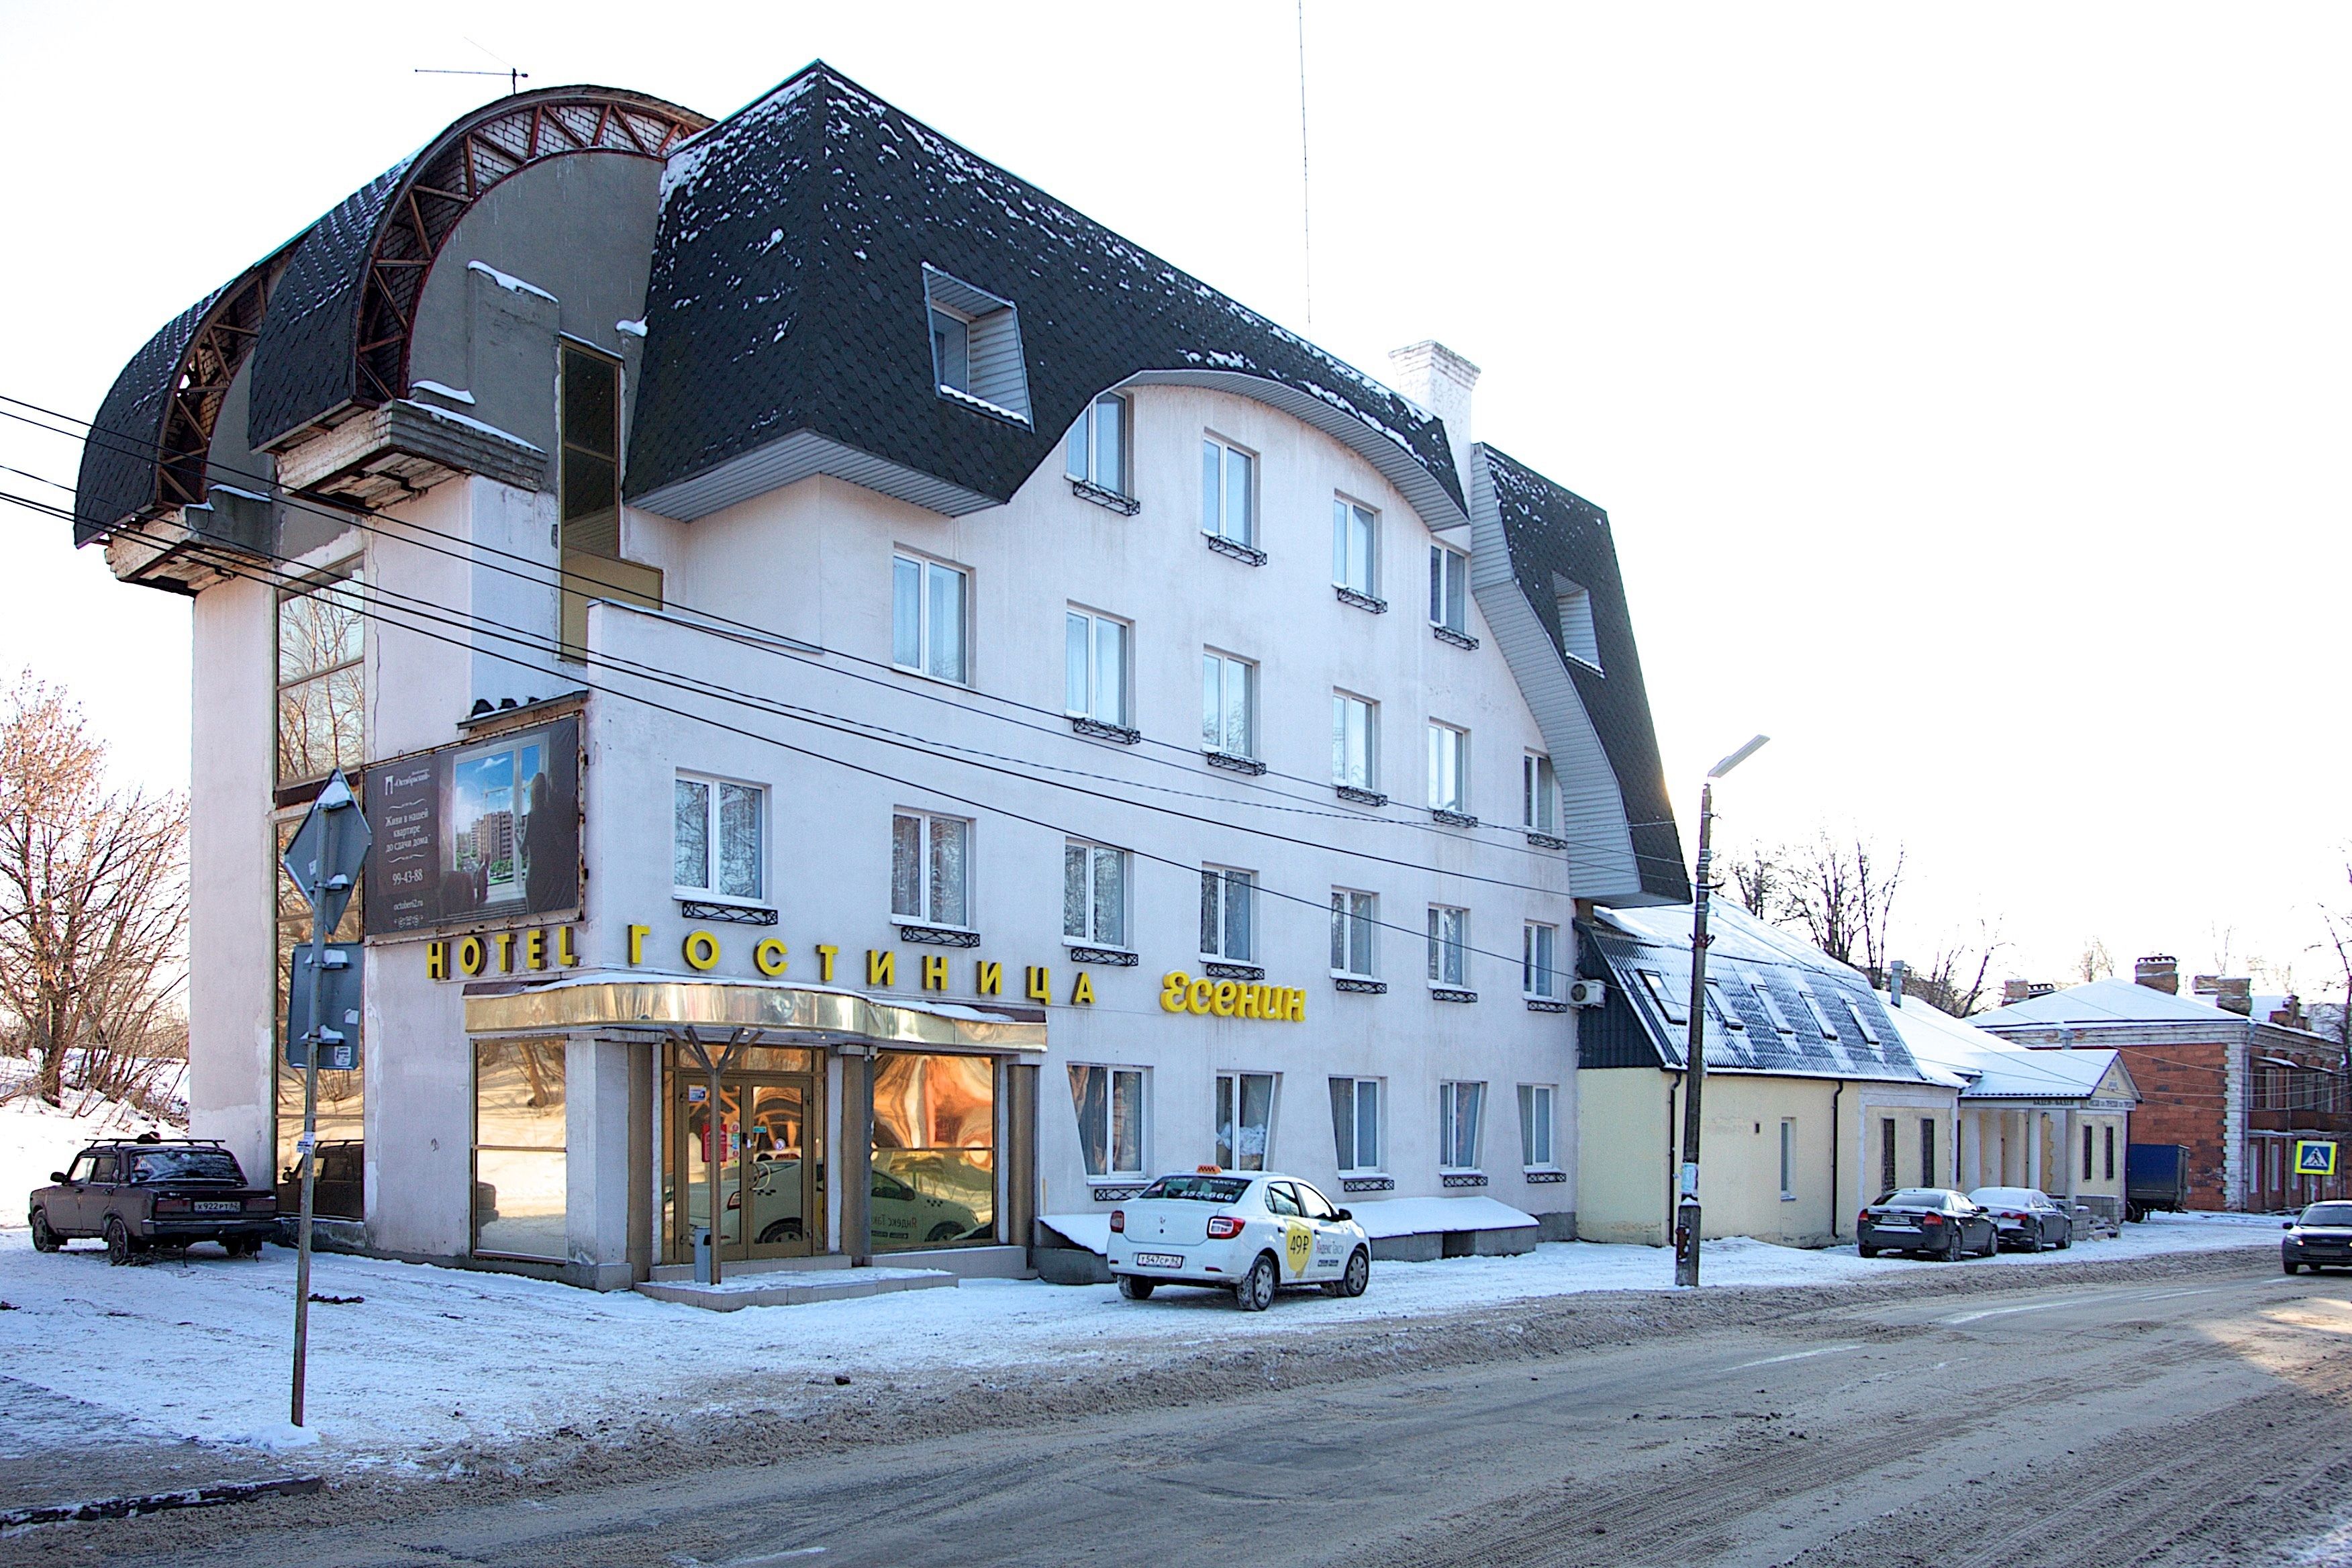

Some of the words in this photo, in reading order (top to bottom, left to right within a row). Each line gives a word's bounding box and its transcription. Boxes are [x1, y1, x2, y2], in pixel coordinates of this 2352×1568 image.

[385, 816, 403, 827] Живи
[404, 815, 408, 823] в
[408, 807, 429, 822] нашей
[393, 825, 421, 838] квартире
[386, 844, 393, 852] до
[394, 840, 412, 850] сдачи
[393, 869, 423, 885] 99-43-88
[426, 926, 581, 981] HOTEL
[628, 924, 1096, 1006] ГОСТИНИЦА
[1160, 969, 1306, 1024] Есенин
[1180, 1190, 1233, 1201] 555-666
